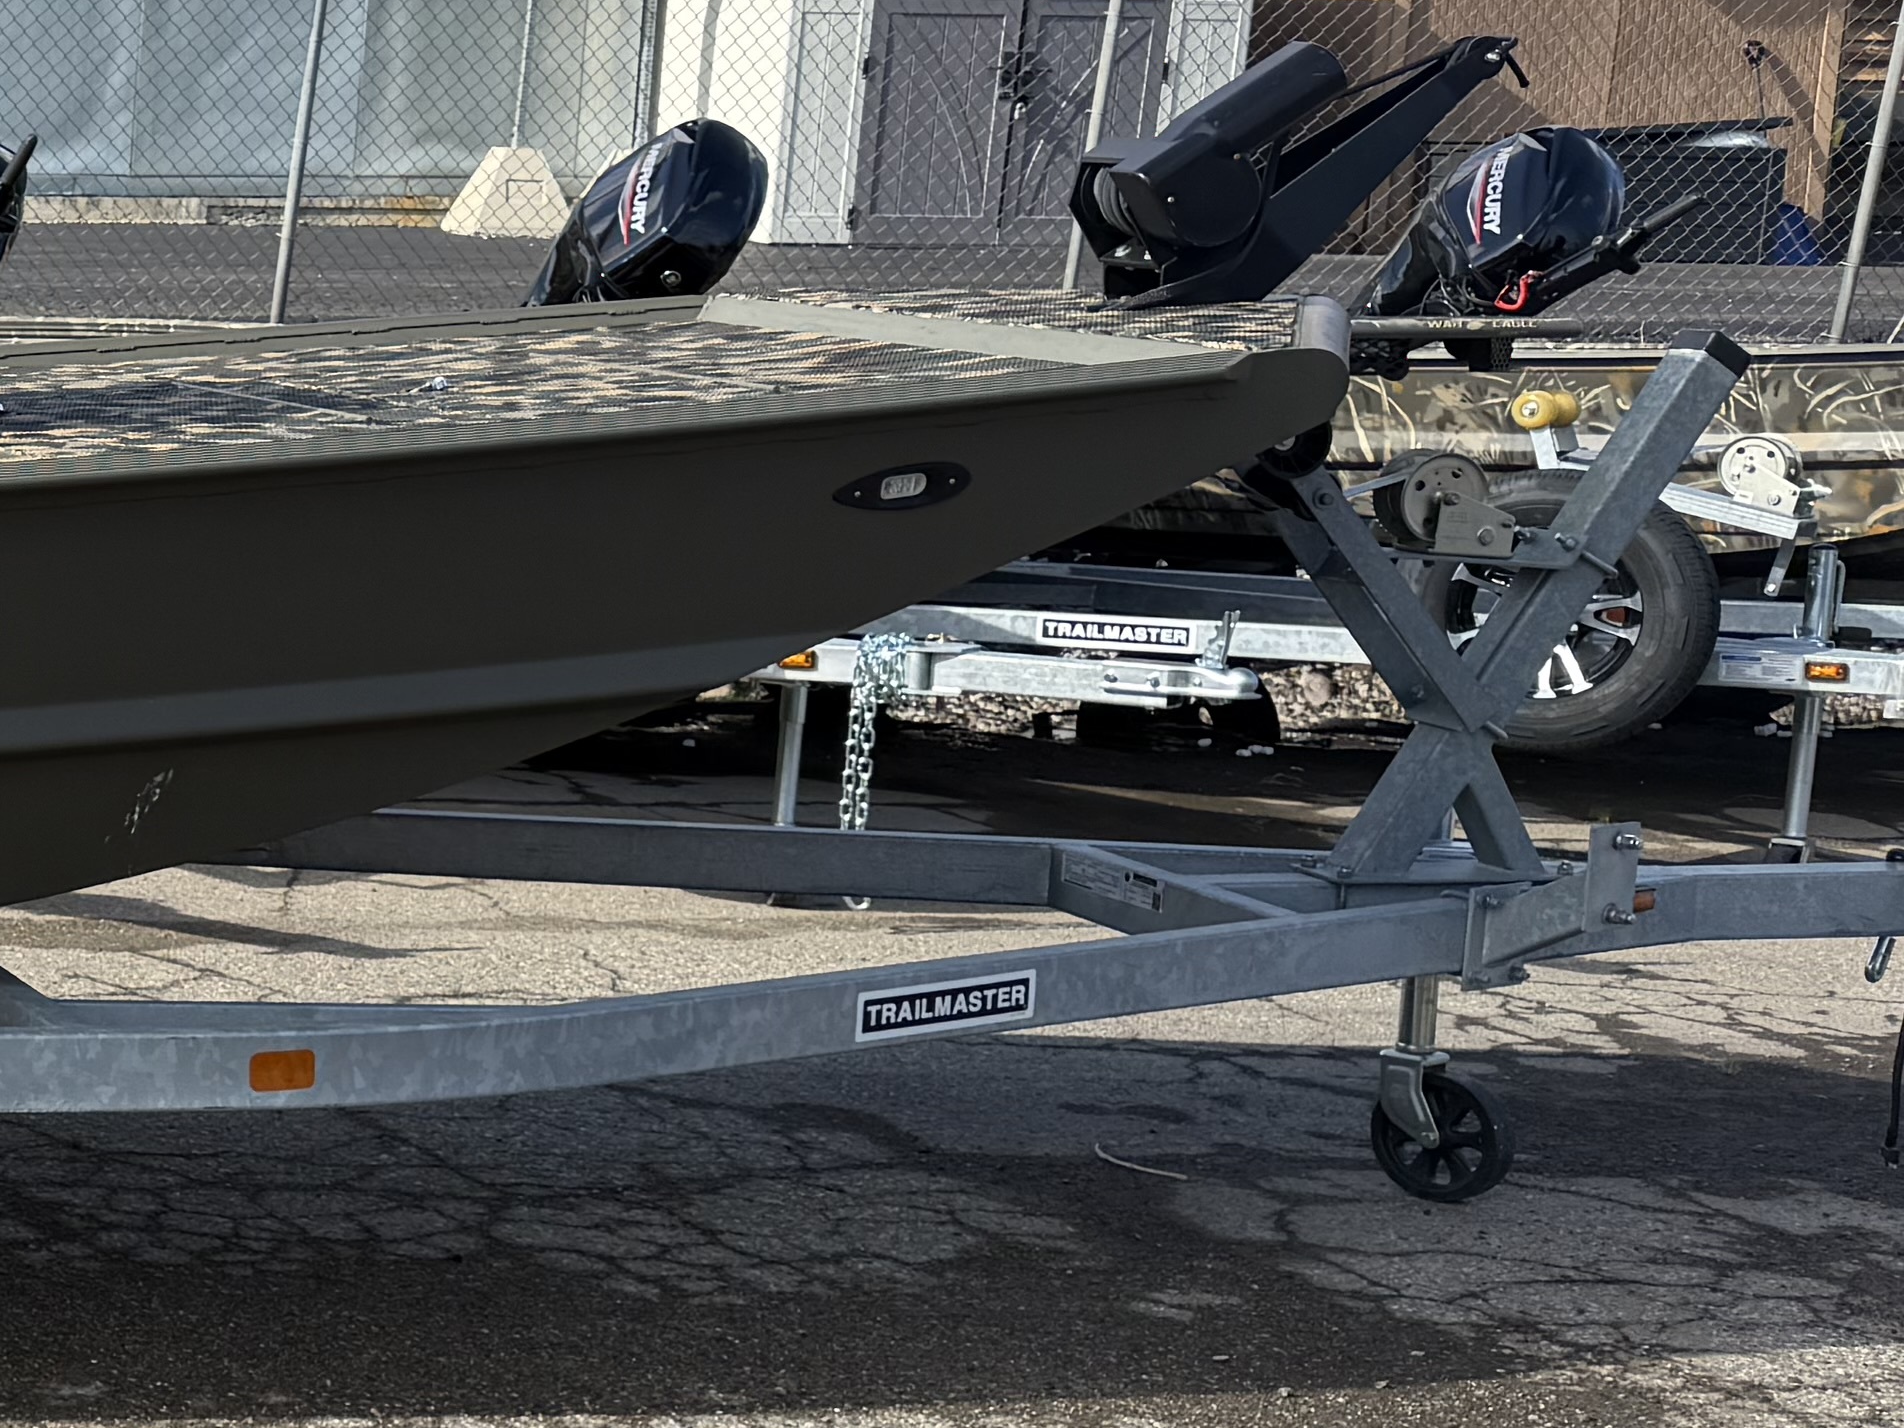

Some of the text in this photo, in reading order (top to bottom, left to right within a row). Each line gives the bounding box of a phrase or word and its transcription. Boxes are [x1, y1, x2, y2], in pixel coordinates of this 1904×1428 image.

[630, 141, 663, 235] MERCURY
[1481, 144, 1515, 236] MERCURY
[1045, 621, 1188, 645] TRAILMASTER
[867, 984, 1026, 1027] TRAILMASTER
